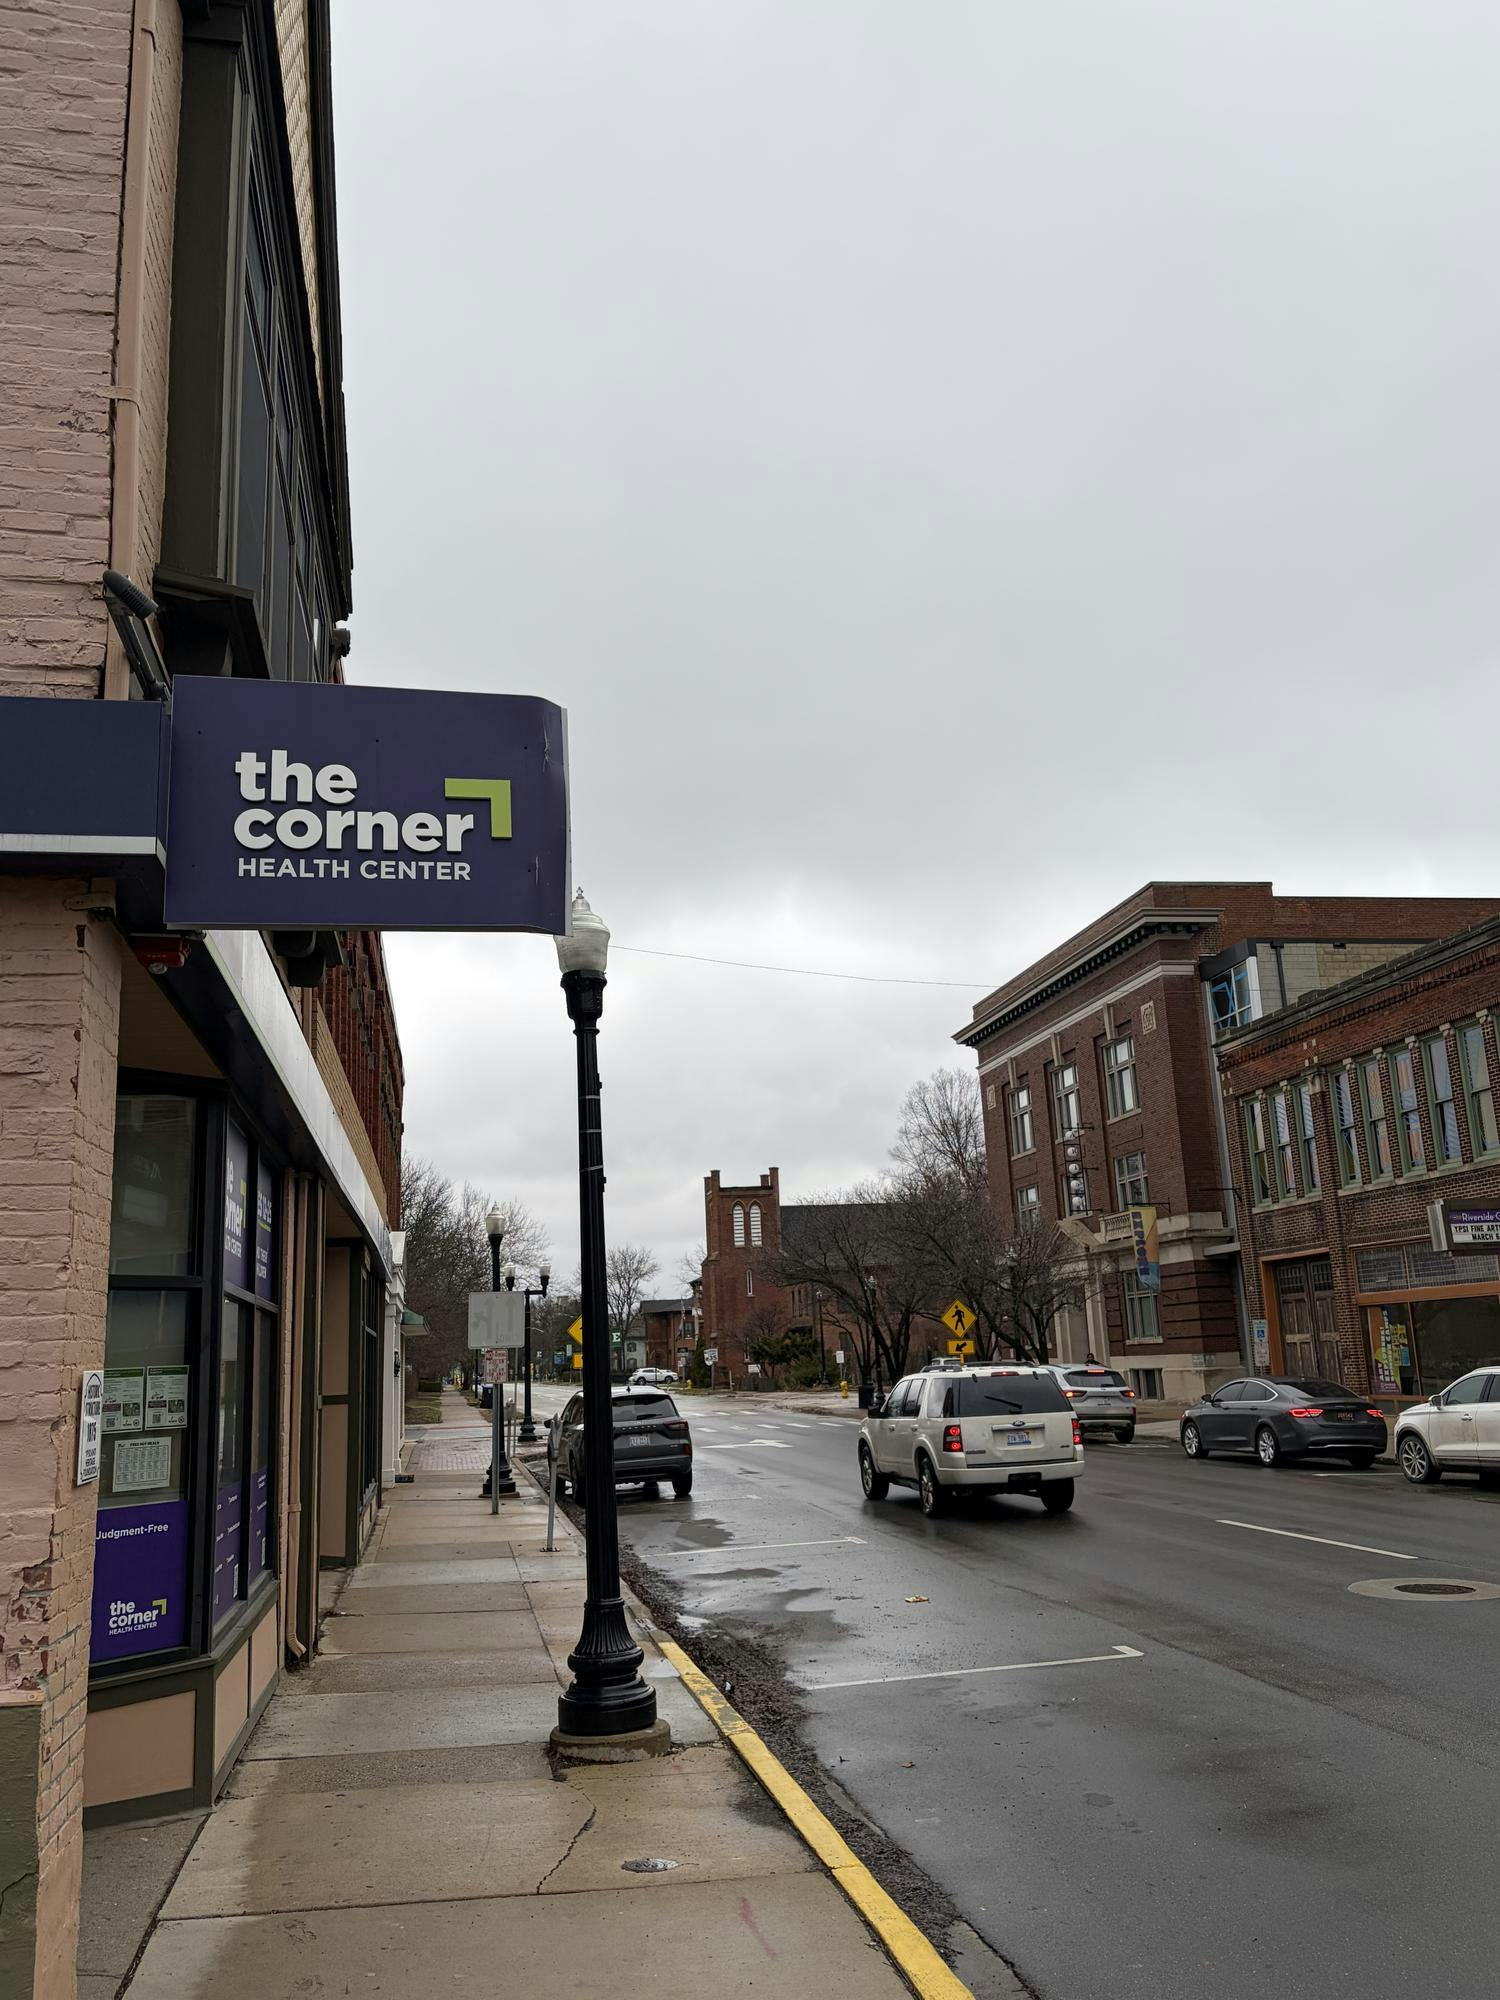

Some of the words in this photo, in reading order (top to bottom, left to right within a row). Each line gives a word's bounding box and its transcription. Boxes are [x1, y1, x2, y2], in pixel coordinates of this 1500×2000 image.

[235, 749, 358, 804] the
[233, 808, 474, 852] corner
[238, 857, 350, 878] HEALTH
[360, 860, 471, 881] CENTER
[1462, 1211, 1494, 1222] Riverside
[1454, 1225, 1470, 1233] YPSI
[1470, 1225, 1485, 1233] FINE
[1472, 1233, 1494, 1241] MARCH
[612, 1332, 621, 1343] E
[96, 1524, 169, 1540] Judgment-Free
[109, 1600, 136, 1617] the
[109, 1609, 159, 1629] corner
[109, 1625, 133, 1637] HEALTH
[133, 1621, 158, 1632] CENTER
